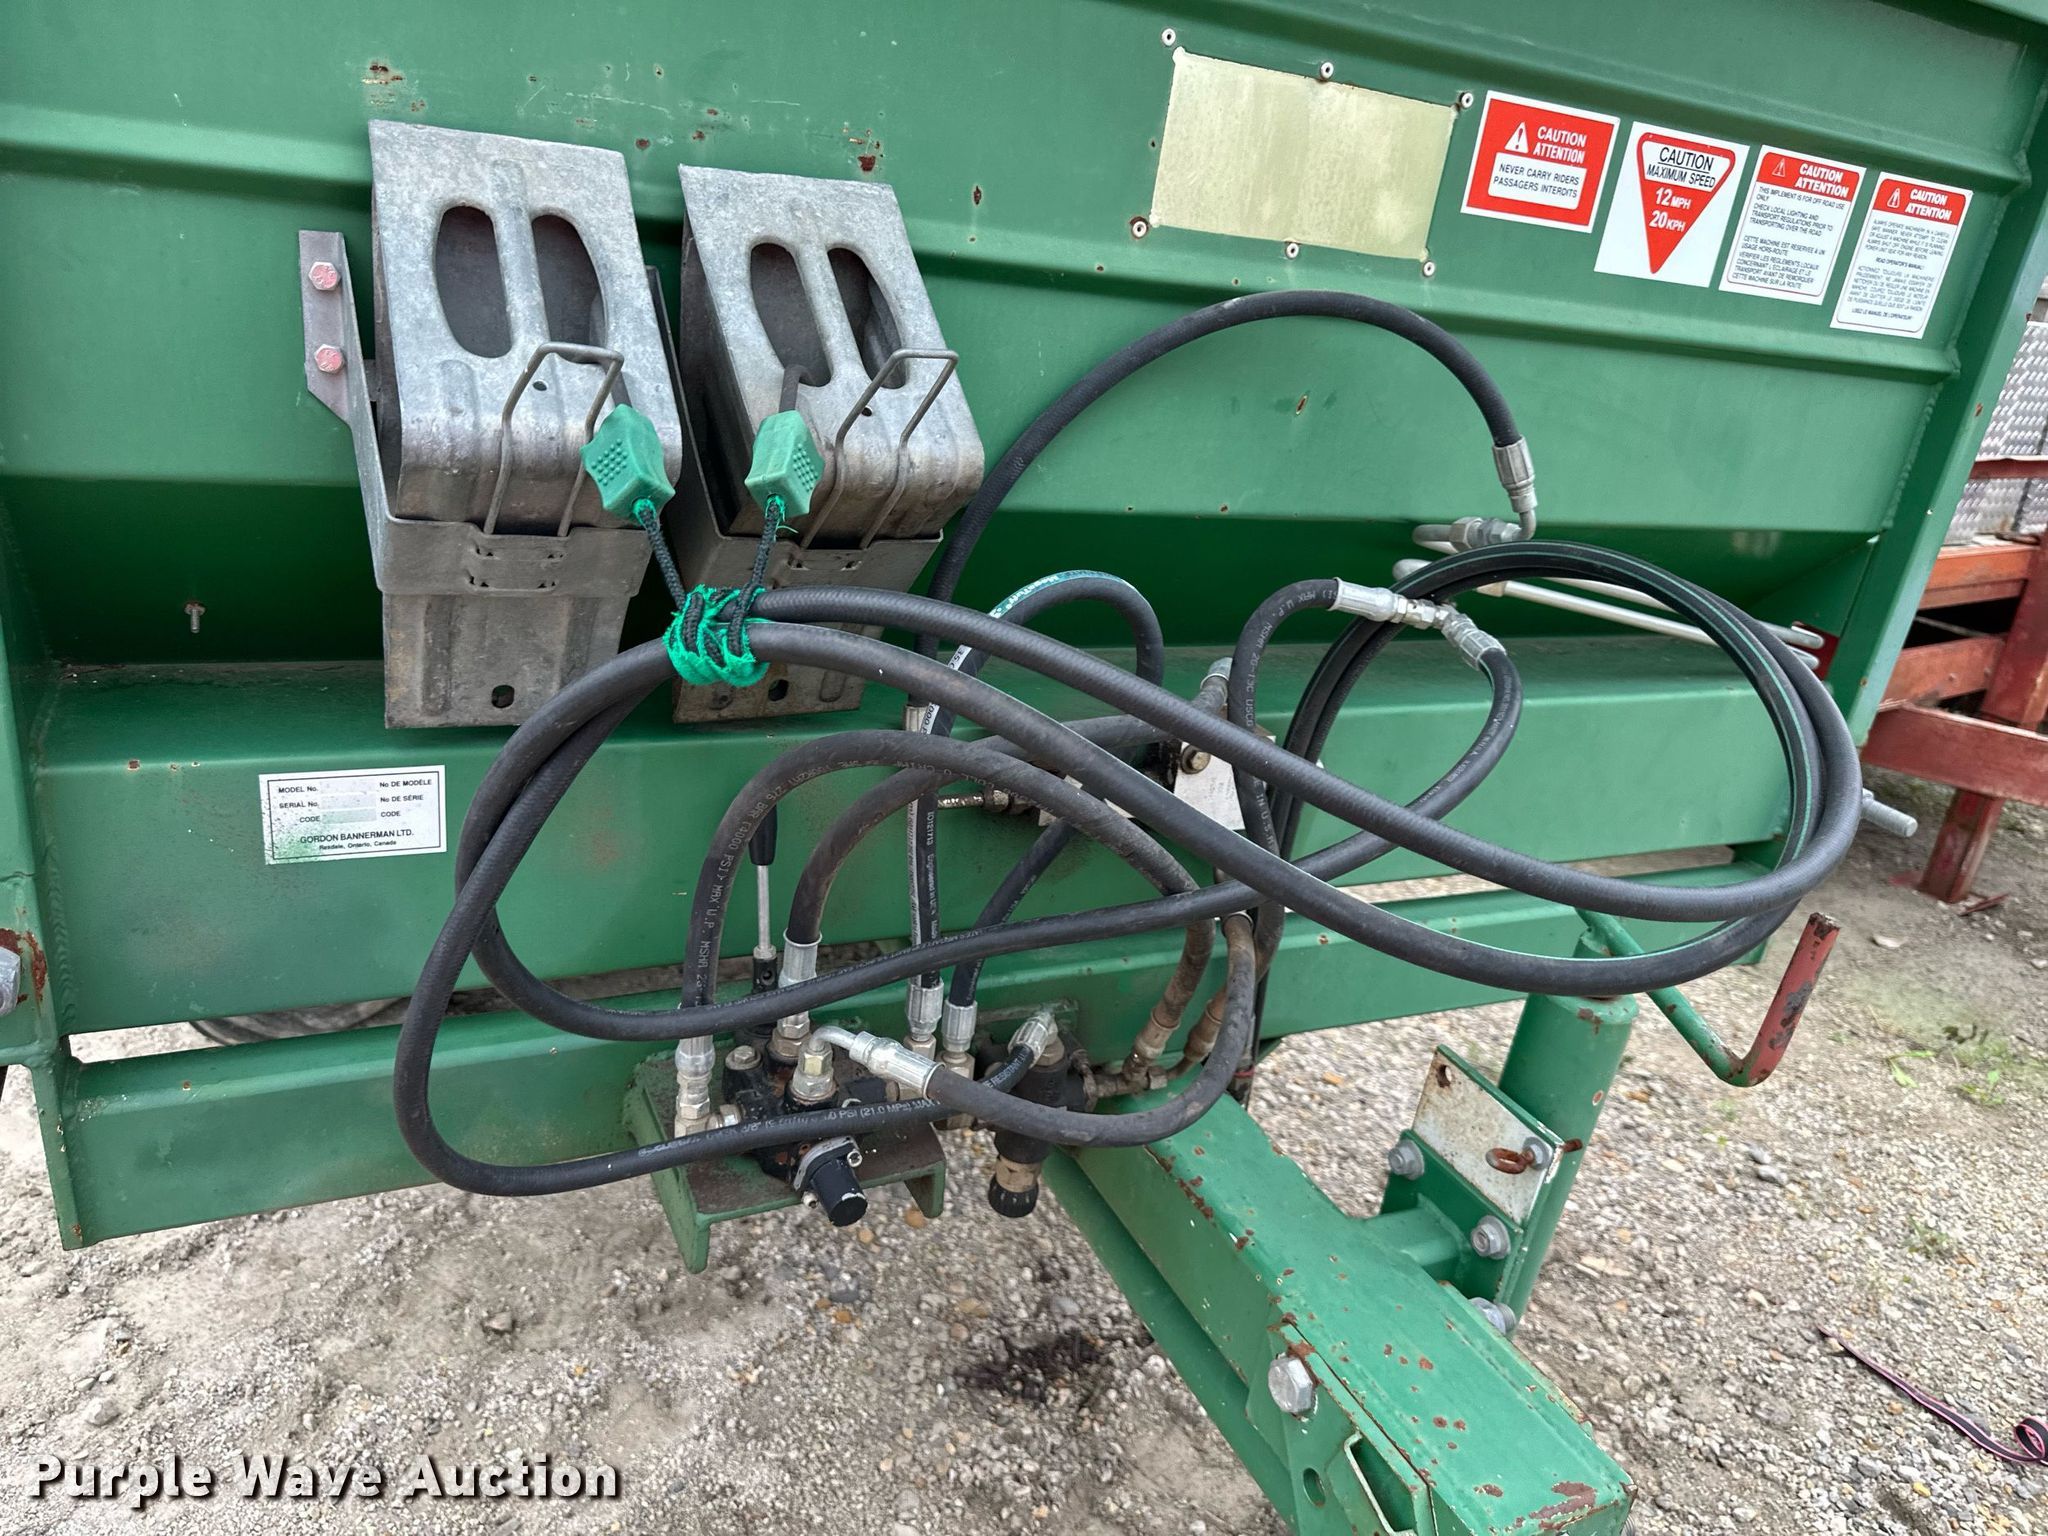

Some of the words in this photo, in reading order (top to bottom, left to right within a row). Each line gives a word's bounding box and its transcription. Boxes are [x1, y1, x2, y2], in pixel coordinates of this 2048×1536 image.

[1537, 126, 1587, 147] CAUTION
[1533, 142, 1585, 164] ATTENTION
[1659, 147, 1714, 171] CAUTION
[1499, 164, 1524, 175] NEVER
[1526, 169, 1551, 180] CARRY
[1554, 173, 1579, 186] RIDERS
[1647, 164, 1687, 182] MAXIMUM
[1688, 173, 1716, 188] SPEED
[1799, 163, 1844, 183] CAUTION
[1493, 176, 1538, 191] PASSAGERS
[1541, 185, 1577, 198] INTERDITS
[1794, 177, 1849, 198] ATTENTION
[1910, 188, 1948, 206] CAUTION
[1656, 187, 1672, 207] 12
[1671, 196, 1691, 210] MPH
[1802, 195, 1813, 203] FOR
[1822, 199, 1836, 207] ROAD
[1649, 210, 1668, 228] 20
[1666, 220, 1686, 232] KPH
[1771, 206, 1786, 215] LOCAL
[1905, 202, 1952, 221] ATTENTION
[1256, 622, 1274, 649] MSHA
[278, 785, 305, 794] MODEL
[306, 785, 319, 793] No.
[402, 794, 424, 802] SÉRIE
[279, 801, 306, 809] SERIAL
[300, 834, 339, 844] GORDON
[340, 830, 395, 842] BANNERMAN
[396, 829, 414, 838] LTD.
[711, 885, 725, 906] MAX
[699, 939, 712, 969] MSHA
[839, 1109, 858, 1119] PSI
[860, 1106, 885, 1119] (21.0
